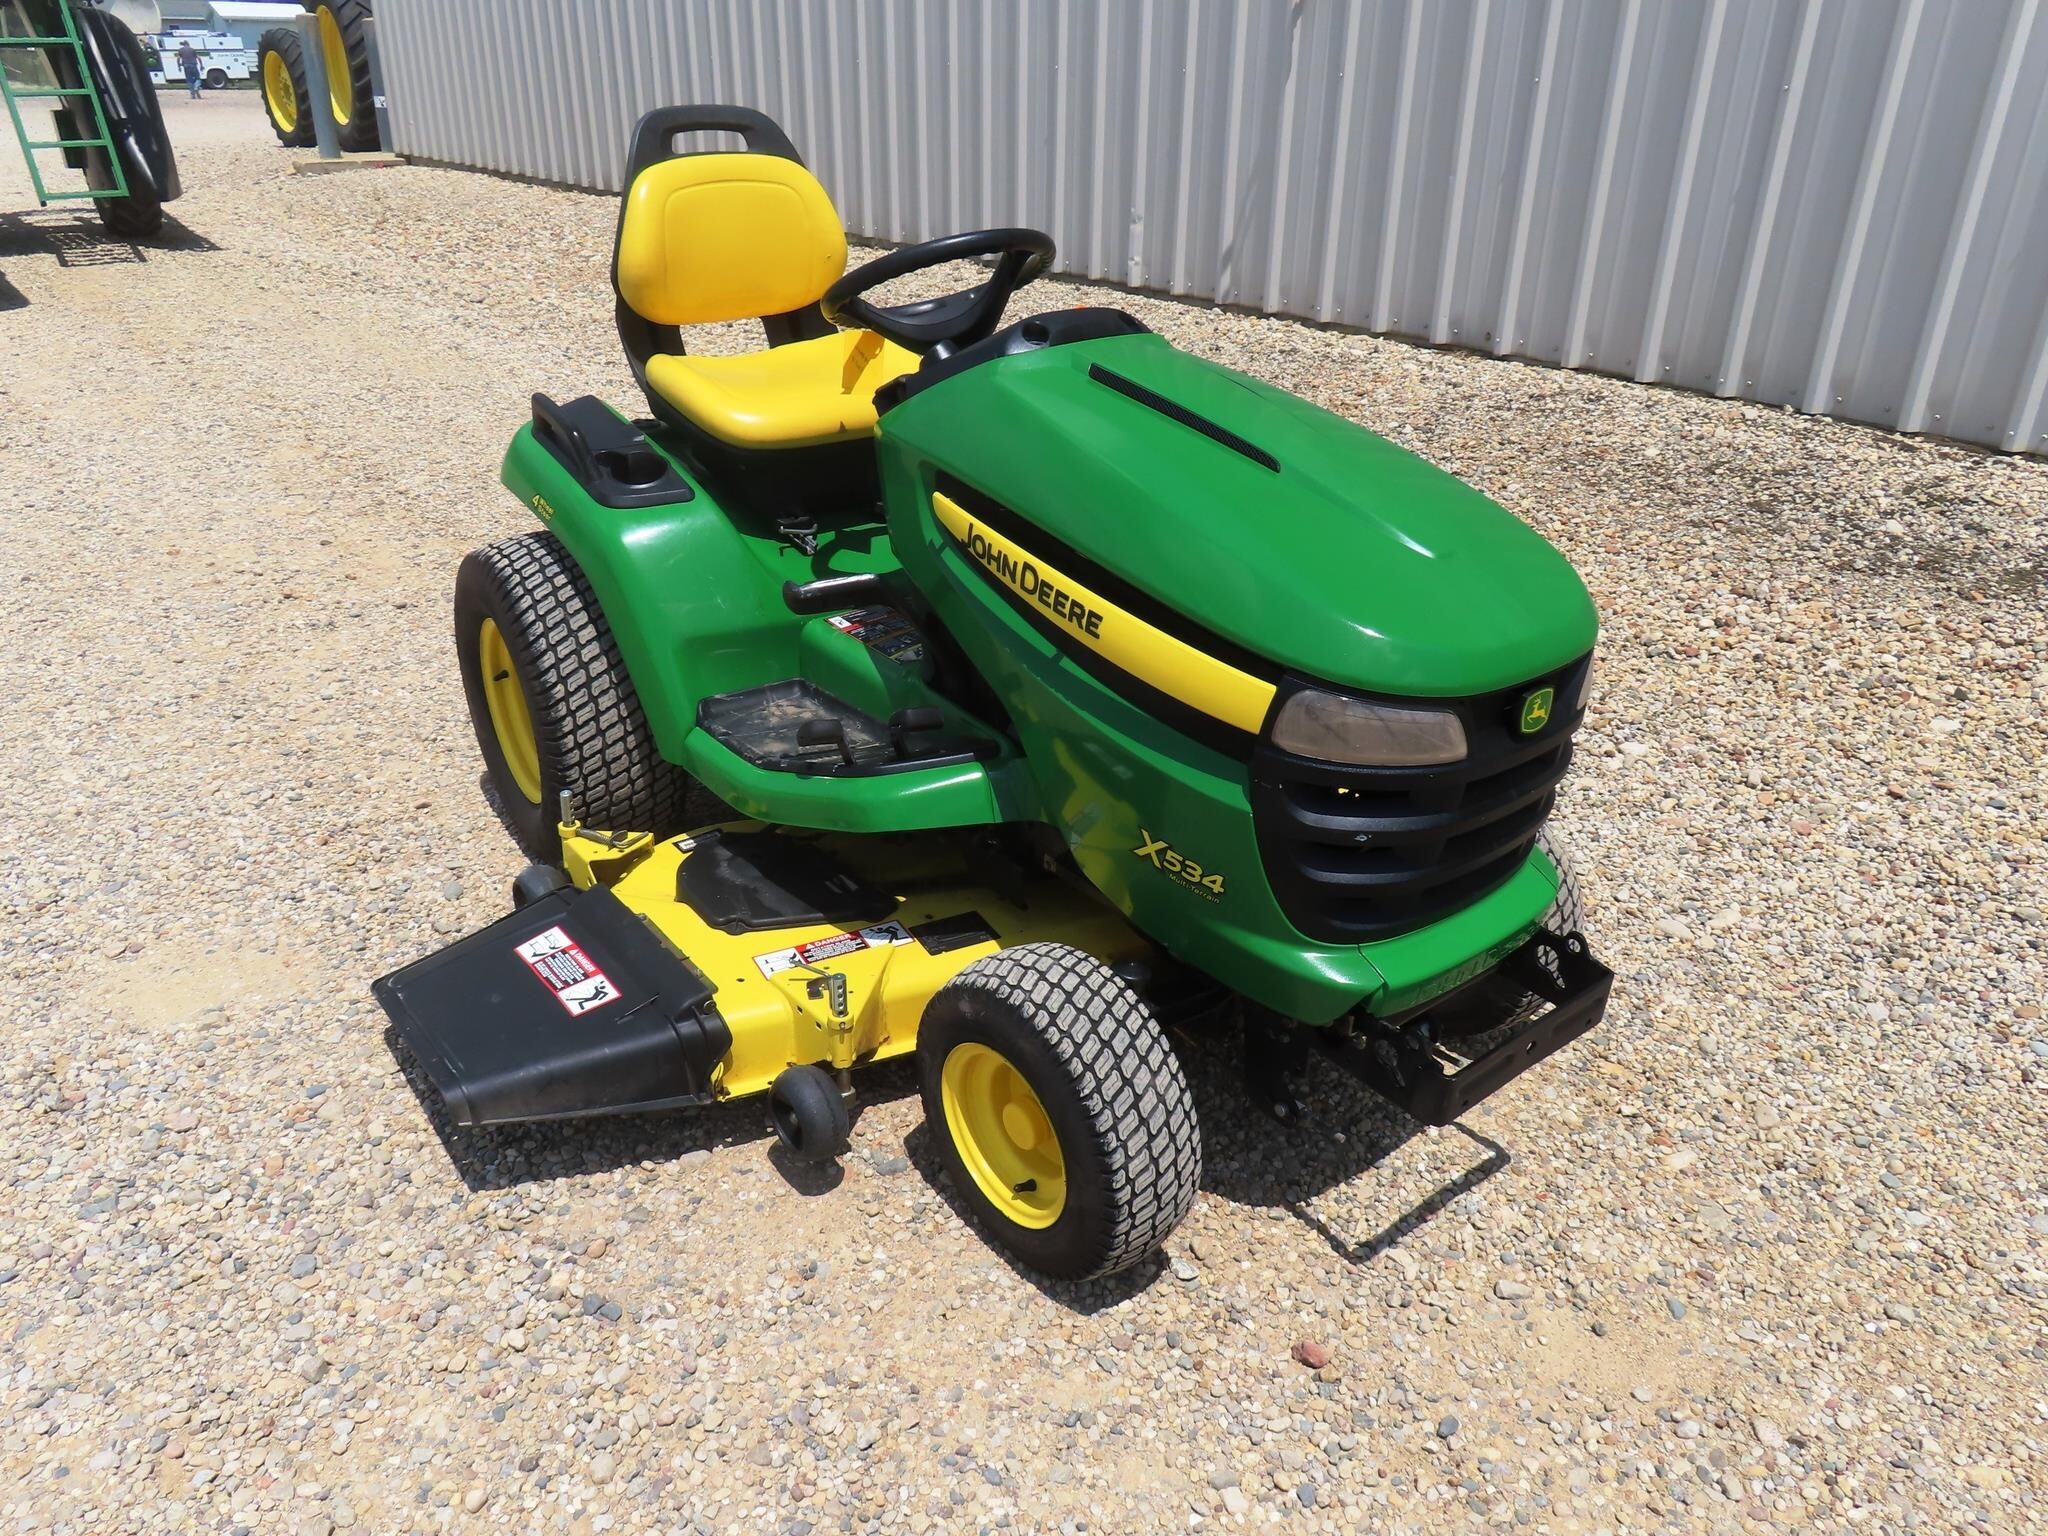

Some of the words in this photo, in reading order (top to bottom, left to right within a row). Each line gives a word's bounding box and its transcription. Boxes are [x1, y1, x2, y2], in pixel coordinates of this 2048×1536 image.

[961, 522, 1018, 585] JOHN
[1020, 560, 1104, 640] DEERE
[1133, 828, 1225, 894] X534
[814, 933, 852, 947] DANGER
